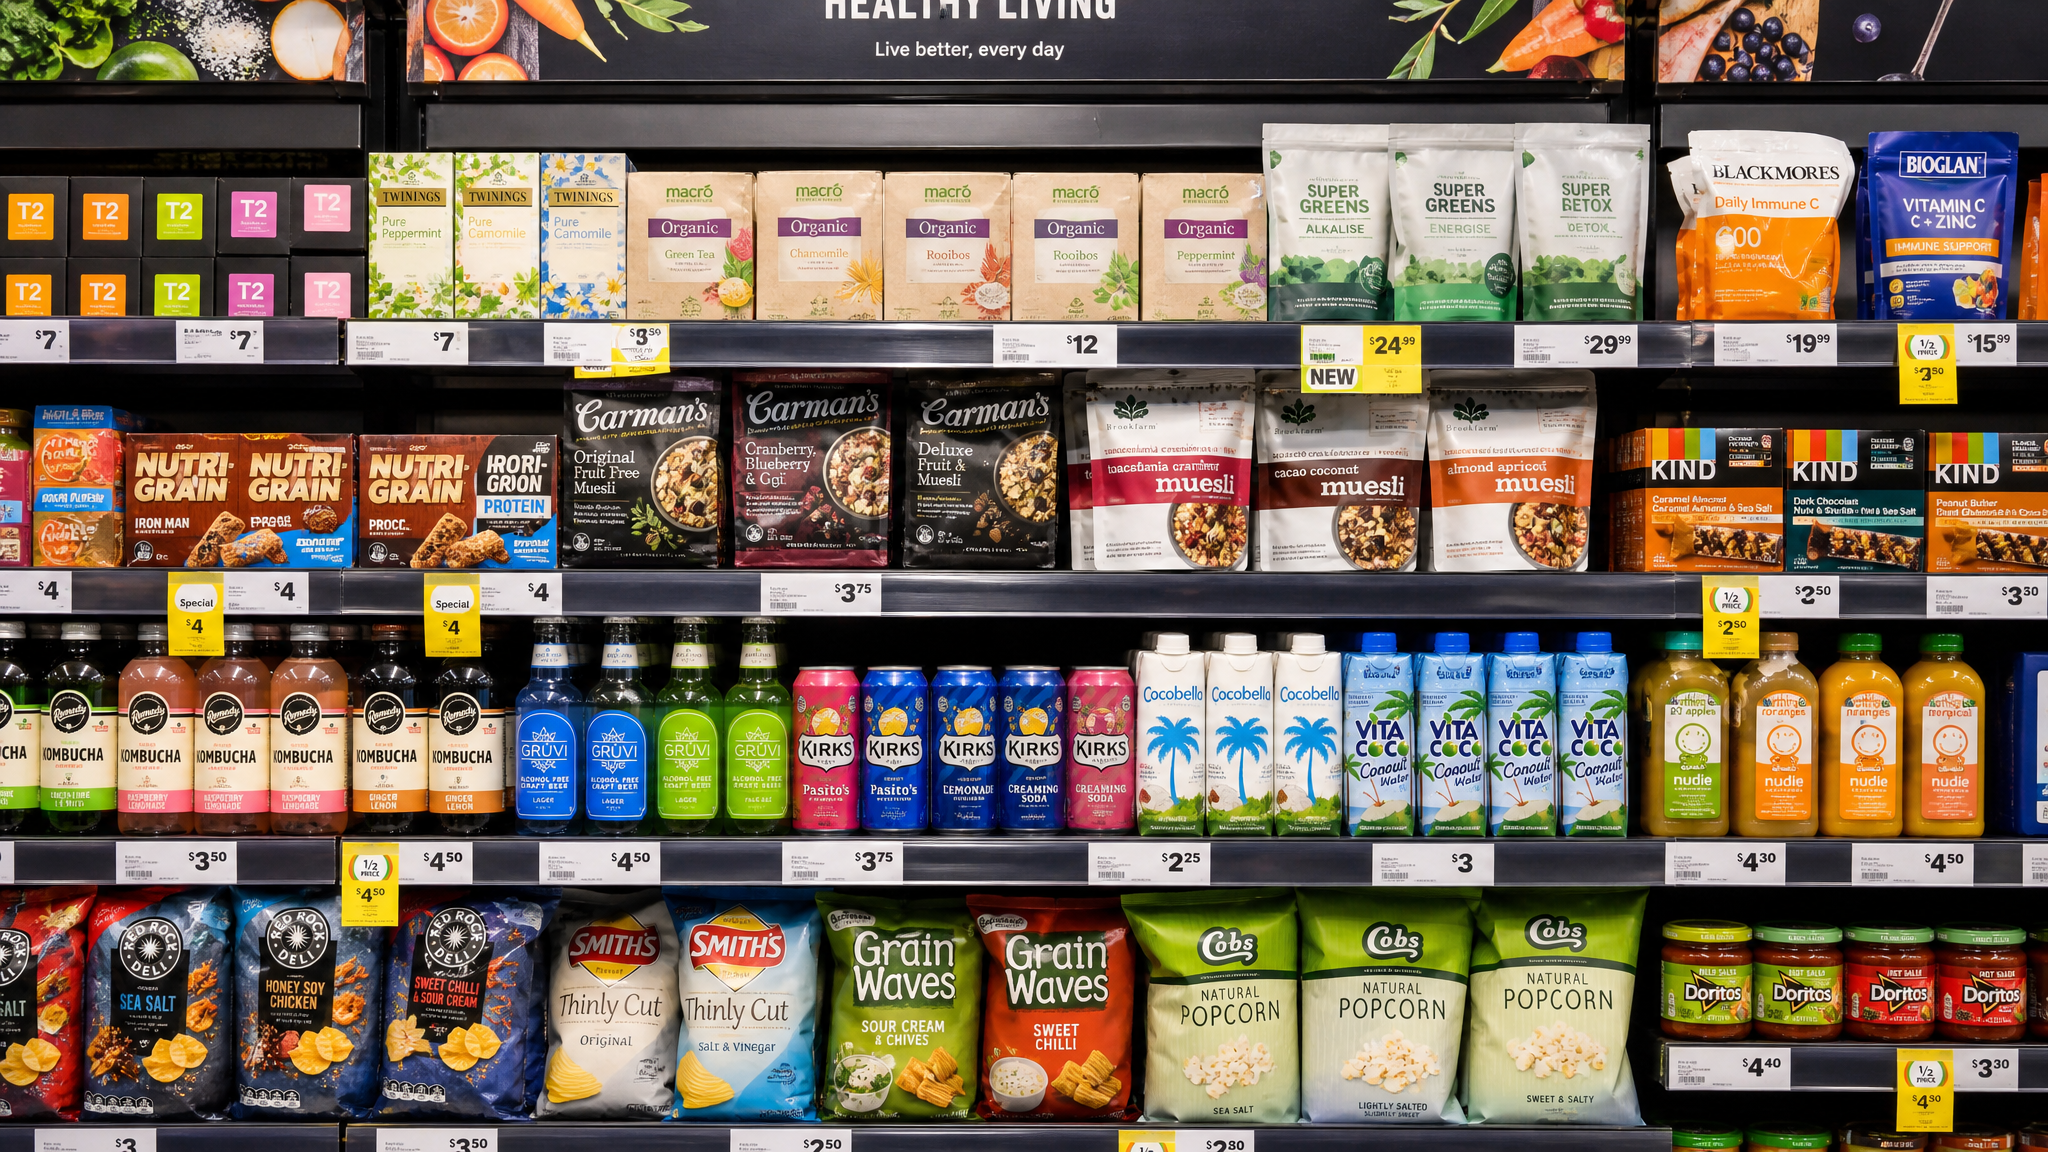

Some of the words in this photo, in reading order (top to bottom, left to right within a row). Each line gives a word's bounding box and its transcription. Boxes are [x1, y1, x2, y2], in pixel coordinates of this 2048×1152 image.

[875, 42, 909, 56] Live
[916, 42, 973, 59] better,
[979, 44, 1027, 60] every
[1032, 42, 1064, 60] day
[1713, 165, 1840, 181] BLACKMORES
[1907, 156, 1977, 174] BIOGLAN
[383, 191, 441, 203] TWININGS
[469, 191, 527, 202] TWININGS
[554, 192, 613, 203] TWININGS
[1308, 184, 1359, 198] SUPER
[1434, 183, 1485, 197] SUPER
[1562, 183, 1610, 196] SUPER
[166, 201, 192, 220] T2
[240, 200, 267, 218] T2
[314, 193, 341, 212] T2
[1300, 199, 1370, 214] GREENS
[1425, 199, 1495, 213] GREENS
[1715, 197, 1748, 211] Daily
[1752, 198, 1806, 209] Immune
[1810, 198, 1819, 209] C
[1903, 198, 1970, 213] VITAMIN
[1975, 198, 1985, 212] C
[17, 202, 43, 220] T2
[92, 202, 118, 220] T2
[382, 216, 406, 227] Pure
[468, 216, 492, 227] Pure
[554, 216, 578, 227] Pure
[661, 221, 719, 236] Organic
[791, 220, 848, 235] Organic
[919, 221, 977, 237] Organic
[1047, 222, 1105, 237] Organic
[1306, 224, 1364, 234] ALKALISE
[1430, 223, 1491, 234] ENERGISE
[1911, 216, 1920, 228] C
[1924, 218, 1932, 227] +
[1936, 215, 1976, 228] ZINC
[382, 227, 442, 240] Peppermint
[468, 227, 526, 239] Camomile
[554, 228, 611, 239] Camomile
[1178, 222, 1235, 238] Organic
[665, 250, 694, 259] Green
[698, 250, 715, 259] Tea
[927, 250, 970, 260] Rooibos
[1053, 250, 1098, 261] Rooibos
[1177, 250, 1235, 263] Peppermint
[15, 282, 42, 300] T2
[89, 282, 116, 300] T2
[163, 282, 190, 300] T2
[238, 281, 264, 300] T2
[314, 281, 341, 299] T2
[1067, 335, 1098, 354] $12
[1310, 368, 1355, 385] NEW
[575, 399, 708, 432] Carman's
[918, 442, 973, 456] Deluxe
[574, 450, 635, 466] Original
[918, 459, 951, 471] Fruit
[956, 459, 966, 471] &
[1652, 460, 1716, 480] KIND
[1793, 461, 1857, 481] KIND
[1935, 464, 1999, 484] KIND
[918, 474, 961, 486] Muesli
[1156, 474, 1234, 494] muesli
[1321, 476, 1405, 495] muesli
[1495, 474, 1575, 495] muesli
[134, 478, 228, 502] GRAIN
[249, 478, 343, 502] GRAIN
[368, 479, 464, 504] GRAIN
[484, 500, 544, 513] PROTEIN
[135, 518, 161, 528] IRON
[165, 518, 189, 528] MAN
[180, 599, 213, 609] Special
[436, 600, 469, 610] Special
[1143, 686, 1202, 702] Cocobella
[1212, 686, 1270, 702] Cocobella
[1280, 686, 1339, 702] Cocobella
[1356, 720, 1404, 740] VITA
[1430, 720, 1478, 740] VITA
[1499, 720, 1548, 740] VITA
[1571, 720, 1619, 740] VITA
[43, 748, 104, 761] KOMBUCHA
[802, 740, 851, 757] KIRKS
[870, 740, 920, 757] KIRKS
[942, 740, 994, 757] KIRKS
[1009, 740, 1059, 757] KIRKS
[1077, 740, 1126, 756] KIRKS
[356, 750, 417, 763] KOMBUCHA
[1674, 774, 1712, 786] nudie
[1765, 775, 1803, 788] nudie
[1850, 775, 1888, 788] nudie
[1931, 775, 1970, 788] nudie
[803, 784, 850, 796] Pasito's
[1022, 793, 1047, 803] SODA
[1088, 793, 1113, 803] SODA
[363, 860, 378, 871] 1/2
[1452, 854, 1473, 873] $3
[570, 931, 657, 957] SMITH'S
[691, 931, 782, 958] SMITH'S
[854, 931, 954, 967] Grain
[1367, 926, 1419, 960] Cobs
[278, 949, 315, 964] DELI
[434, 947, 470, 963] DELI
[1006, 934, 1106, 970] Grain
[131, 961, 167, 976] DELI
[415, 976, 446, 991] SWEET
[449, 980, 479, 995] CHILLI
[853, 966, 956, 1001] Waves
[1005, 968, 1109, 1004] Waves
[1527, 972, 1588, 985] NATURAL
[266, 980, 300, 994] HONEY
[304, 982, 325, 995] SOY
[1201, 986, 1260, 1001] NATURAL
[1363, 982, 1421, 995] NATURAL
[1685, 983, 1741, 1001] Doritos
[1774, 984, 1831, 1002] Doritos
[1870, 985, 1927, 1002] Doritos
[1963, 985, 2020, 1003] Doritos
[120, 994, 141, 1011] SEA
[146, 995, 176, 1012] SALT
[270, 996, 317, 1009] CHICKEN
[421, 992, 444, 1005] SOUR
[447, 995, 477, 1008] CREAM
[1504, 989, 1613, 1010] POPCORN
[559, 993, 618, 1024] Thinly
[624, 993, 662, 1018] Cut
[685, 998, 744, 1029] Thinly
[751, 998, 789, 1022] Cut
[1181, 1000, 1280, 1027] POPCORN
[1340, 998, 1446, 1020] POPCORN
[862, 1021, 896, 1033] SOUR
[902, 1020, 944, 1032] CREAM
[1034, 1024, 1079, 1036] SWEET
[875, 1035, 881, 1045] &
[887, 1035, 928, 1045] CHIVES
[1035, 1039, 1076, 1050] CHILLI
[1919, 1065, 1933, 1077] 1/2
[1359, 1102, 1393, 1111] LIGHTLY
[1396, 1102, 1428, 1111] SALTED
[1527, 1095, 1554, 1104] SWEET
[1558, 1095, 1565, 1104] &
[1568, 1095, 1594, 1104] SALTY
[1213, 1107, 1232, 1115] SEA
[1233, 1105, 1254, 1115] SALT
